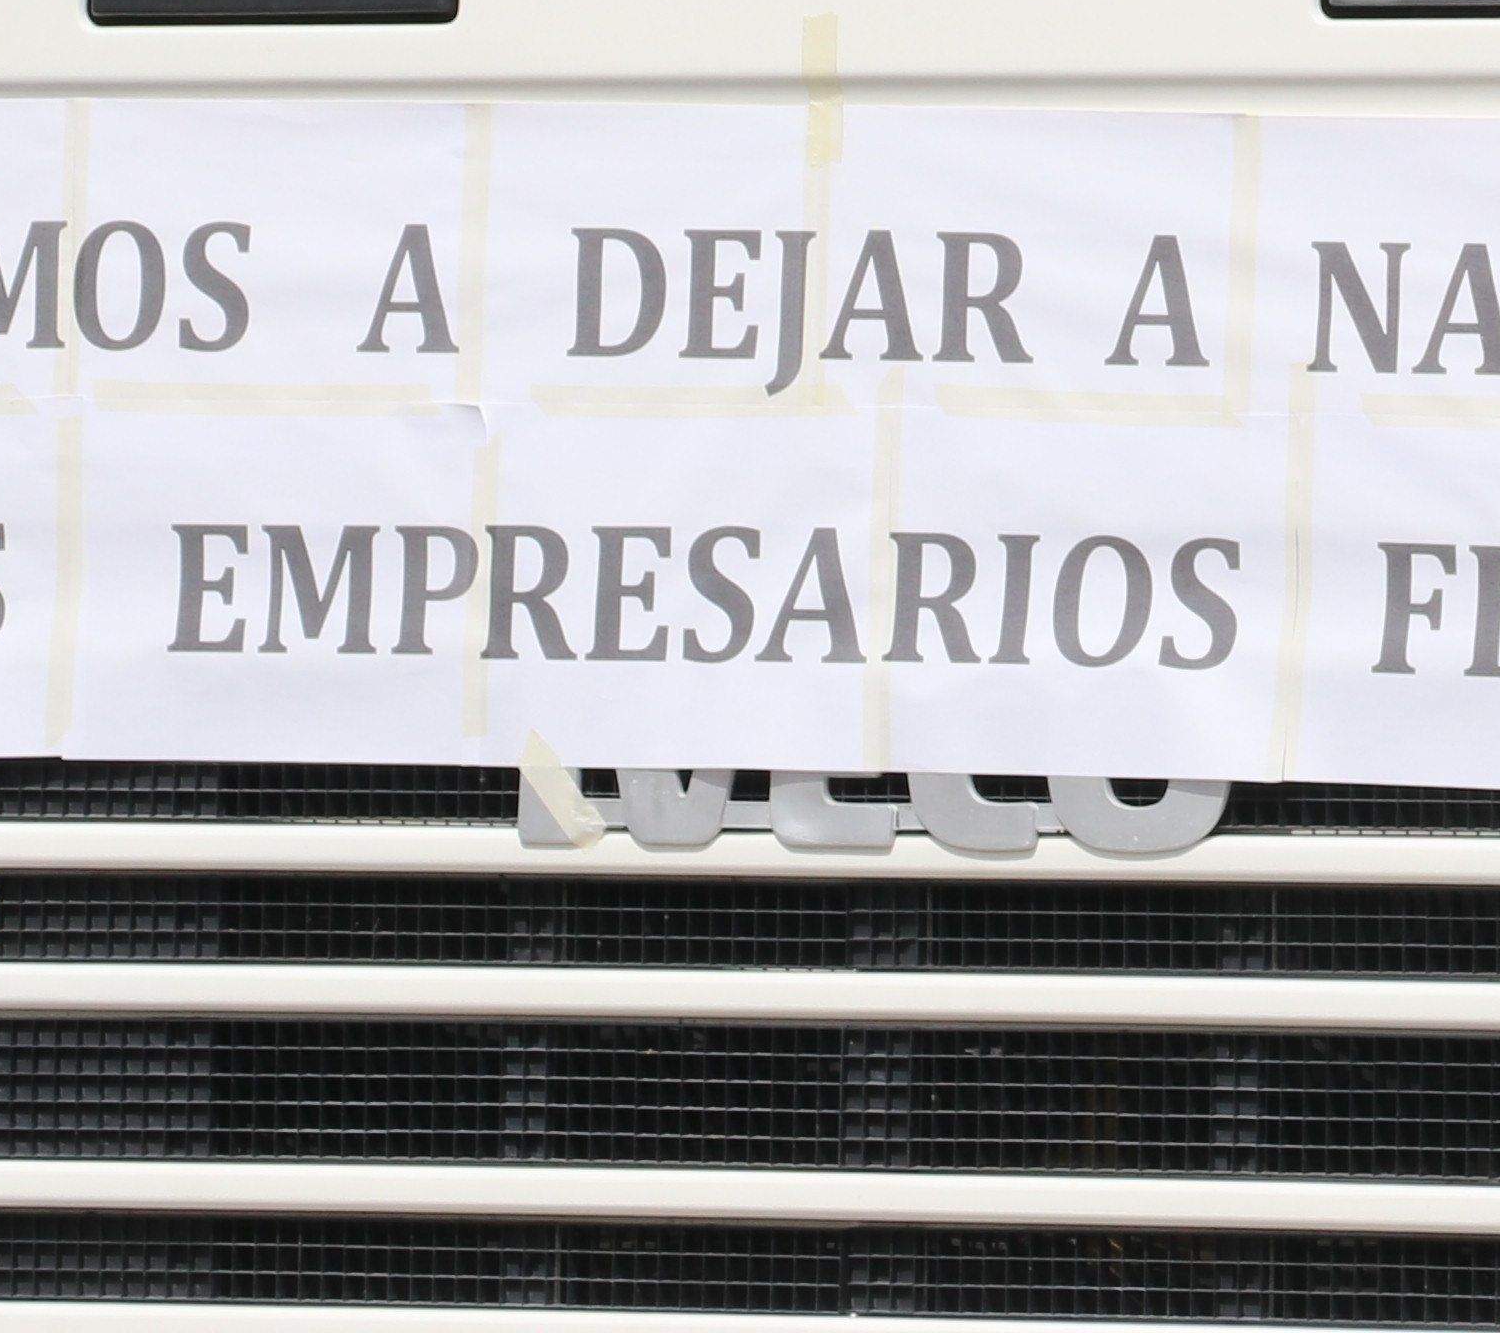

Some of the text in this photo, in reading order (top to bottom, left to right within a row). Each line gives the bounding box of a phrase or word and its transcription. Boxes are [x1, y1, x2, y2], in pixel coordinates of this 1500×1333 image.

[357, 224, 459, 353] A
[567, 228, 1032, 396] DEJAR
[1105, 235, 1208, 367] A
[167, 524, 1241, 669] EMPRESARIOS
